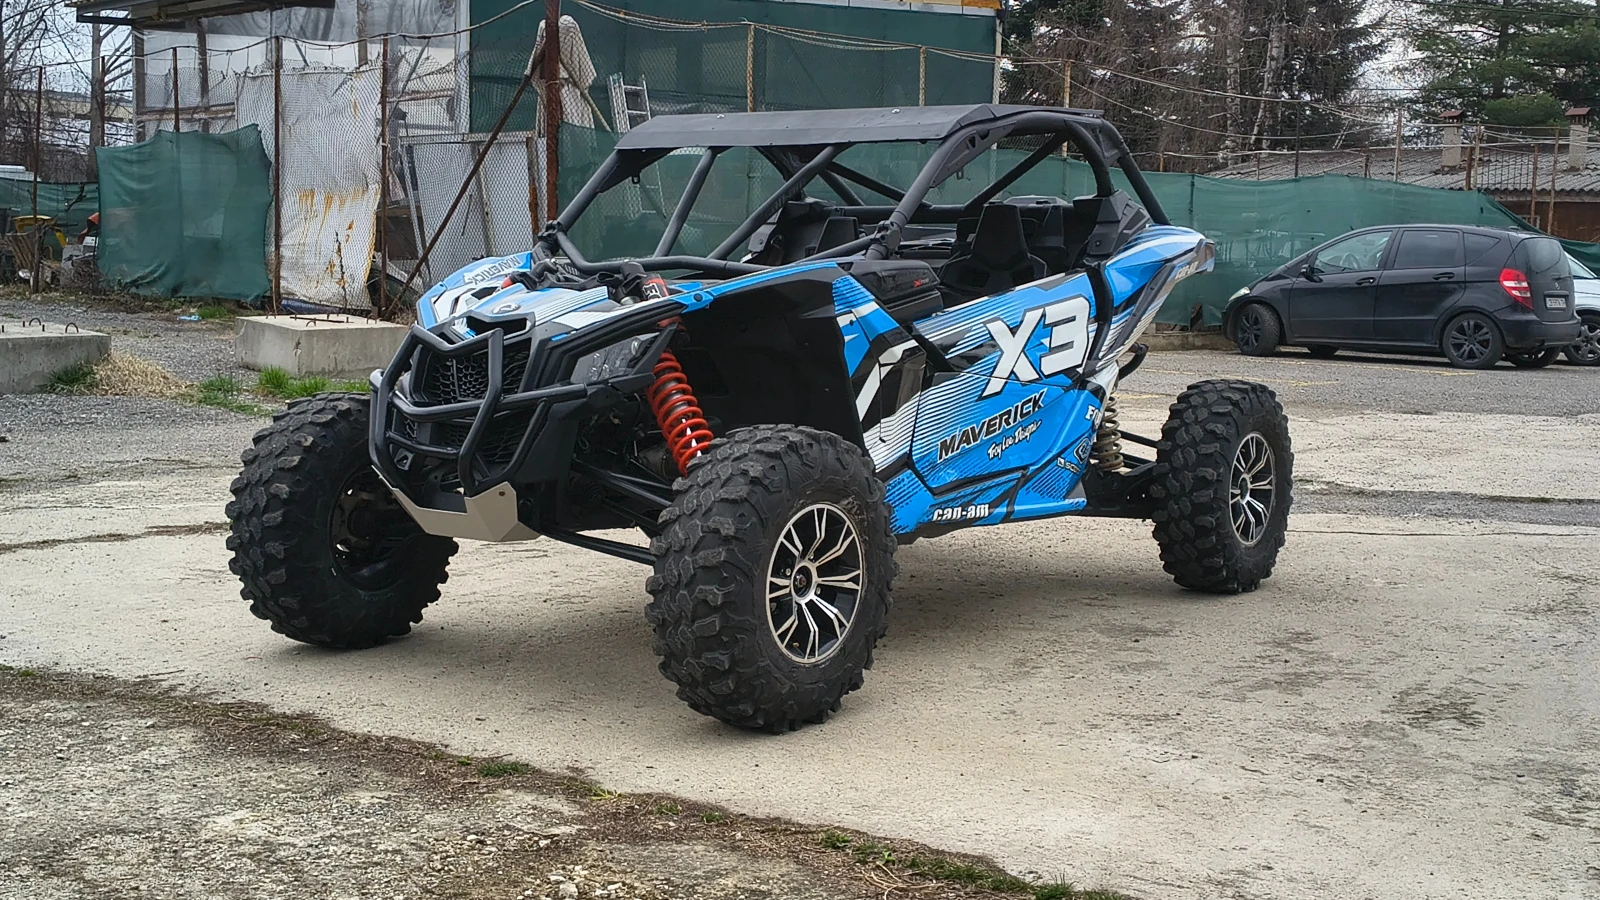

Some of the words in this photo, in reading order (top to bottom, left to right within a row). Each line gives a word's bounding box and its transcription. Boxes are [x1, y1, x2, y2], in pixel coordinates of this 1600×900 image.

[981, 296, 1090, 397] X3
[937, 387, 1048, 463] MAVERICK
[932, 503, 989, 521] can-am
